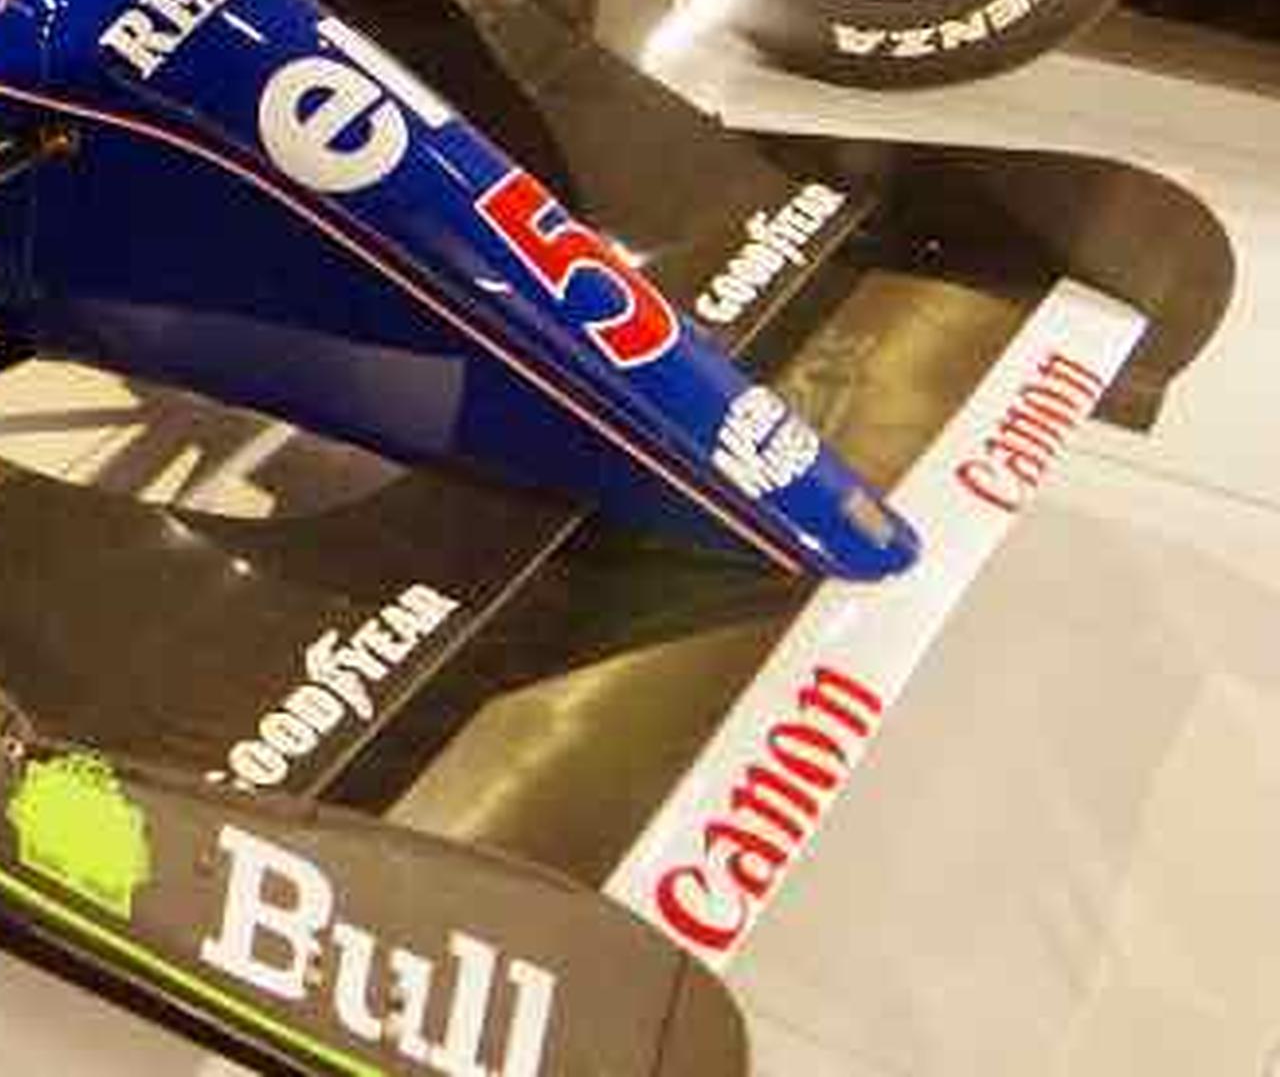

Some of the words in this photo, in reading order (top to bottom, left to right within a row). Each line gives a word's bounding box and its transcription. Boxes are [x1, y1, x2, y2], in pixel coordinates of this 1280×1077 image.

[474, 166, 680, 368] 5
[955, 350, 1103, 514] Canon
[204, 582, 462, 792] OODYEAR
[652, 664, 885, 954] Canon
[199, 824, 558, 1077] Bull
